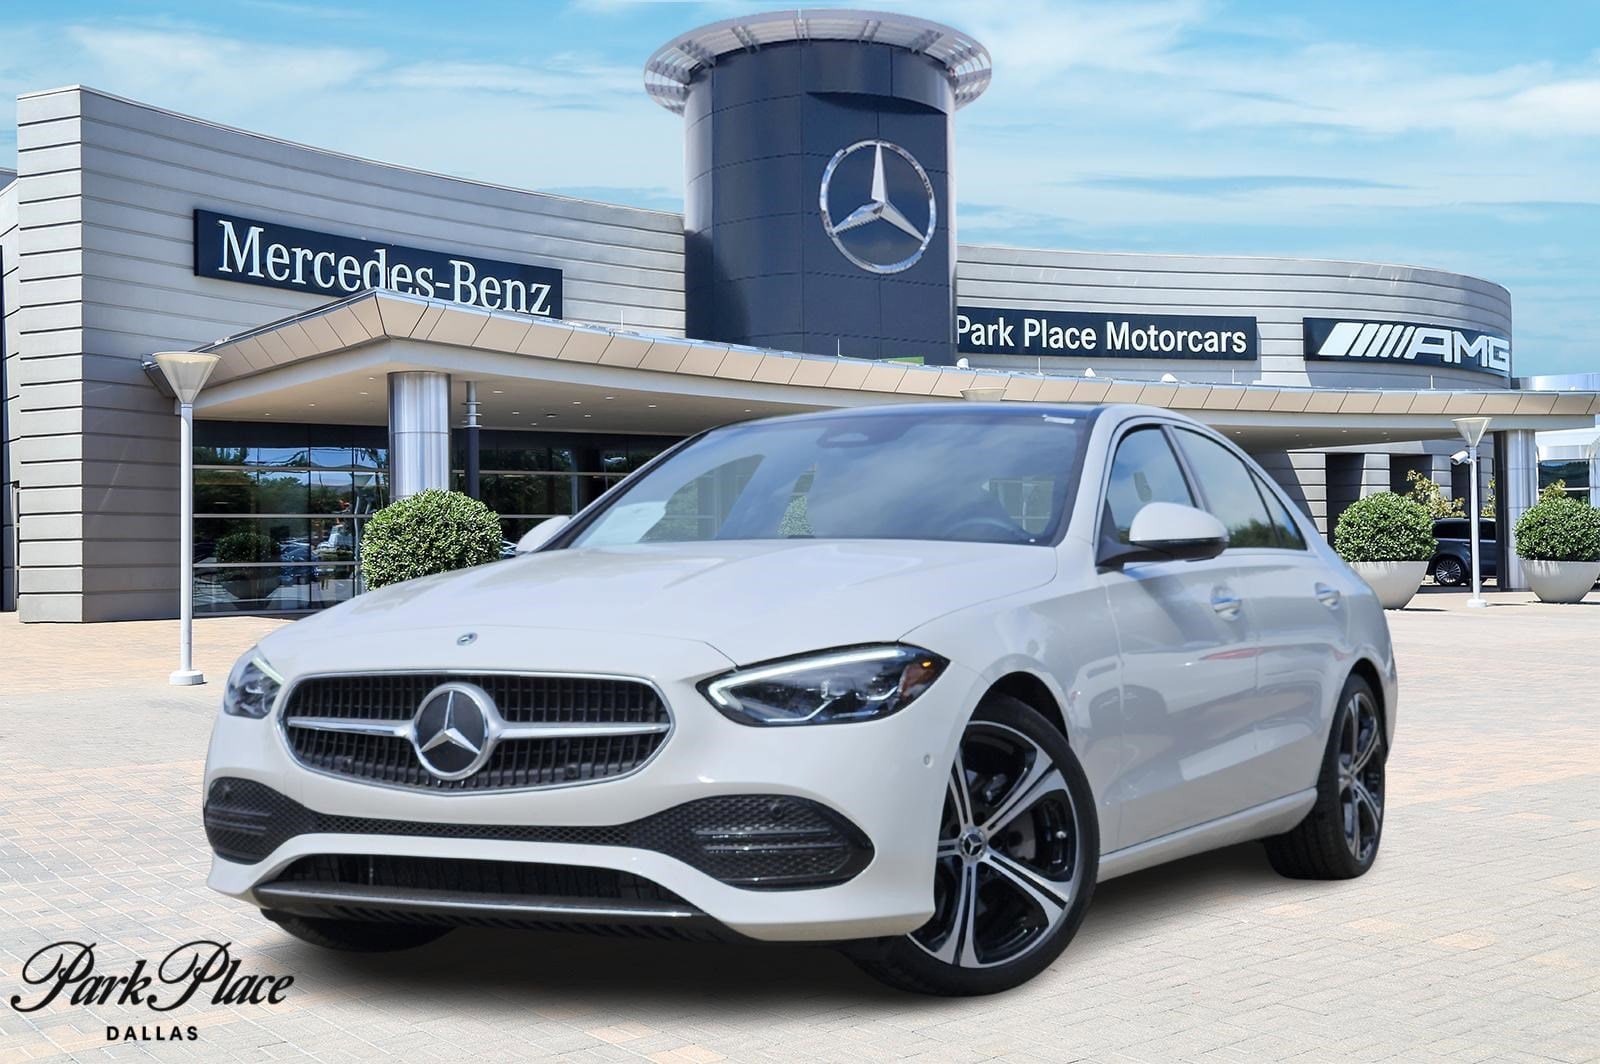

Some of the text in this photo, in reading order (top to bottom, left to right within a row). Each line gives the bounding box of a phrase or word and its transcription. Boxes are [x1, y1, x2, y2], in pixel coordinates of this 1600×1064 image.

[218, 220, 552, 316] Mercedes-Benz
[957, 315, 1248, 353] Park Place Motorcars
[1404, 326, 1510, 373] AMG
